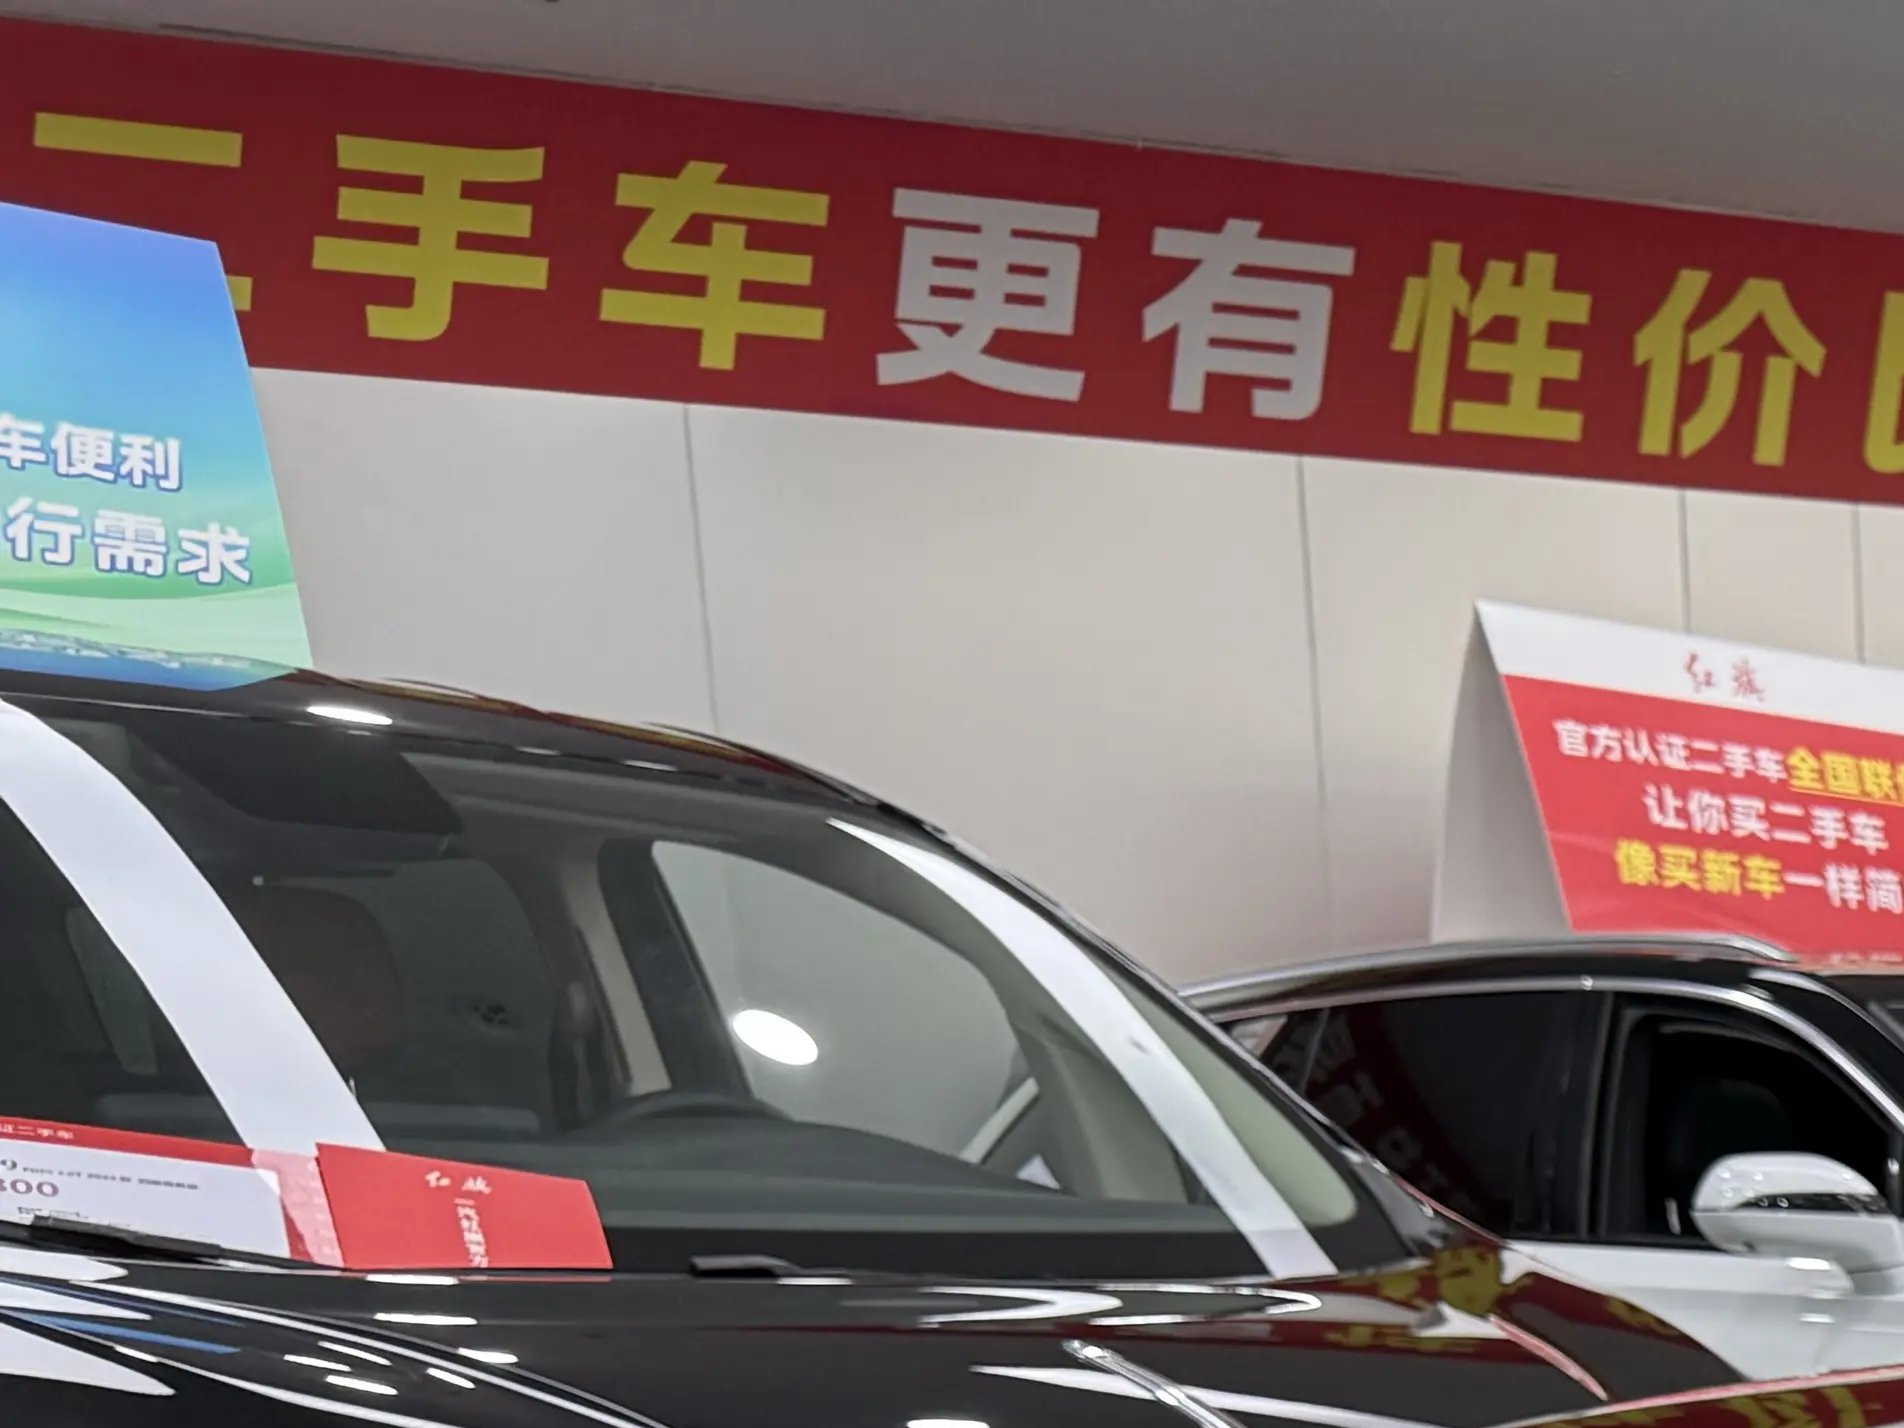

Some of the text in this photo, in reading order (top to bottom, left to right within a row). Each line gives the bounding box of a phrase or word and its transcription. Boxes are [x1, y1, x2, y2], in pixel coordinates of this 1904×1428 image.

[1642, 784, 1889, 856] 让你买二手车
